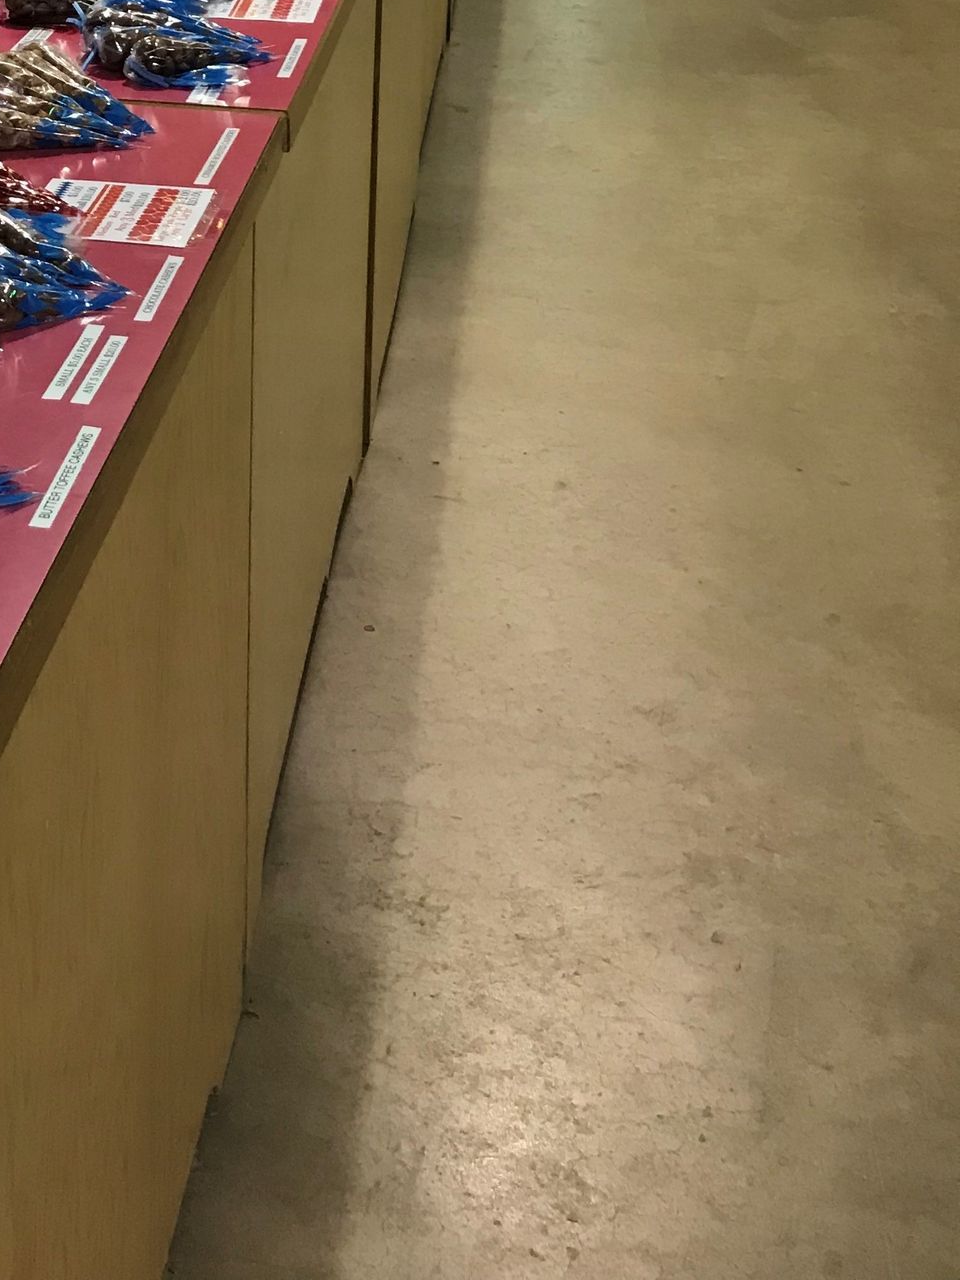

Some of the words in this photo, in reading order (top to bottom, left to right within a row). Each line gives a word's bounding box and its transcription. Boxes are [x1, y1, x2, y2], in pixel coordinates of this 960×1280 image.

[55, 368, 75, 388] SMALL
[76, 337, 93, 353] EACH
[92, 359, 111, 377] SMALL
[39, 491, 61, 519] BUTTER
[53, 465, 77, 491] TOFFEE
[68, 432, 94, 464] CASHEWS
